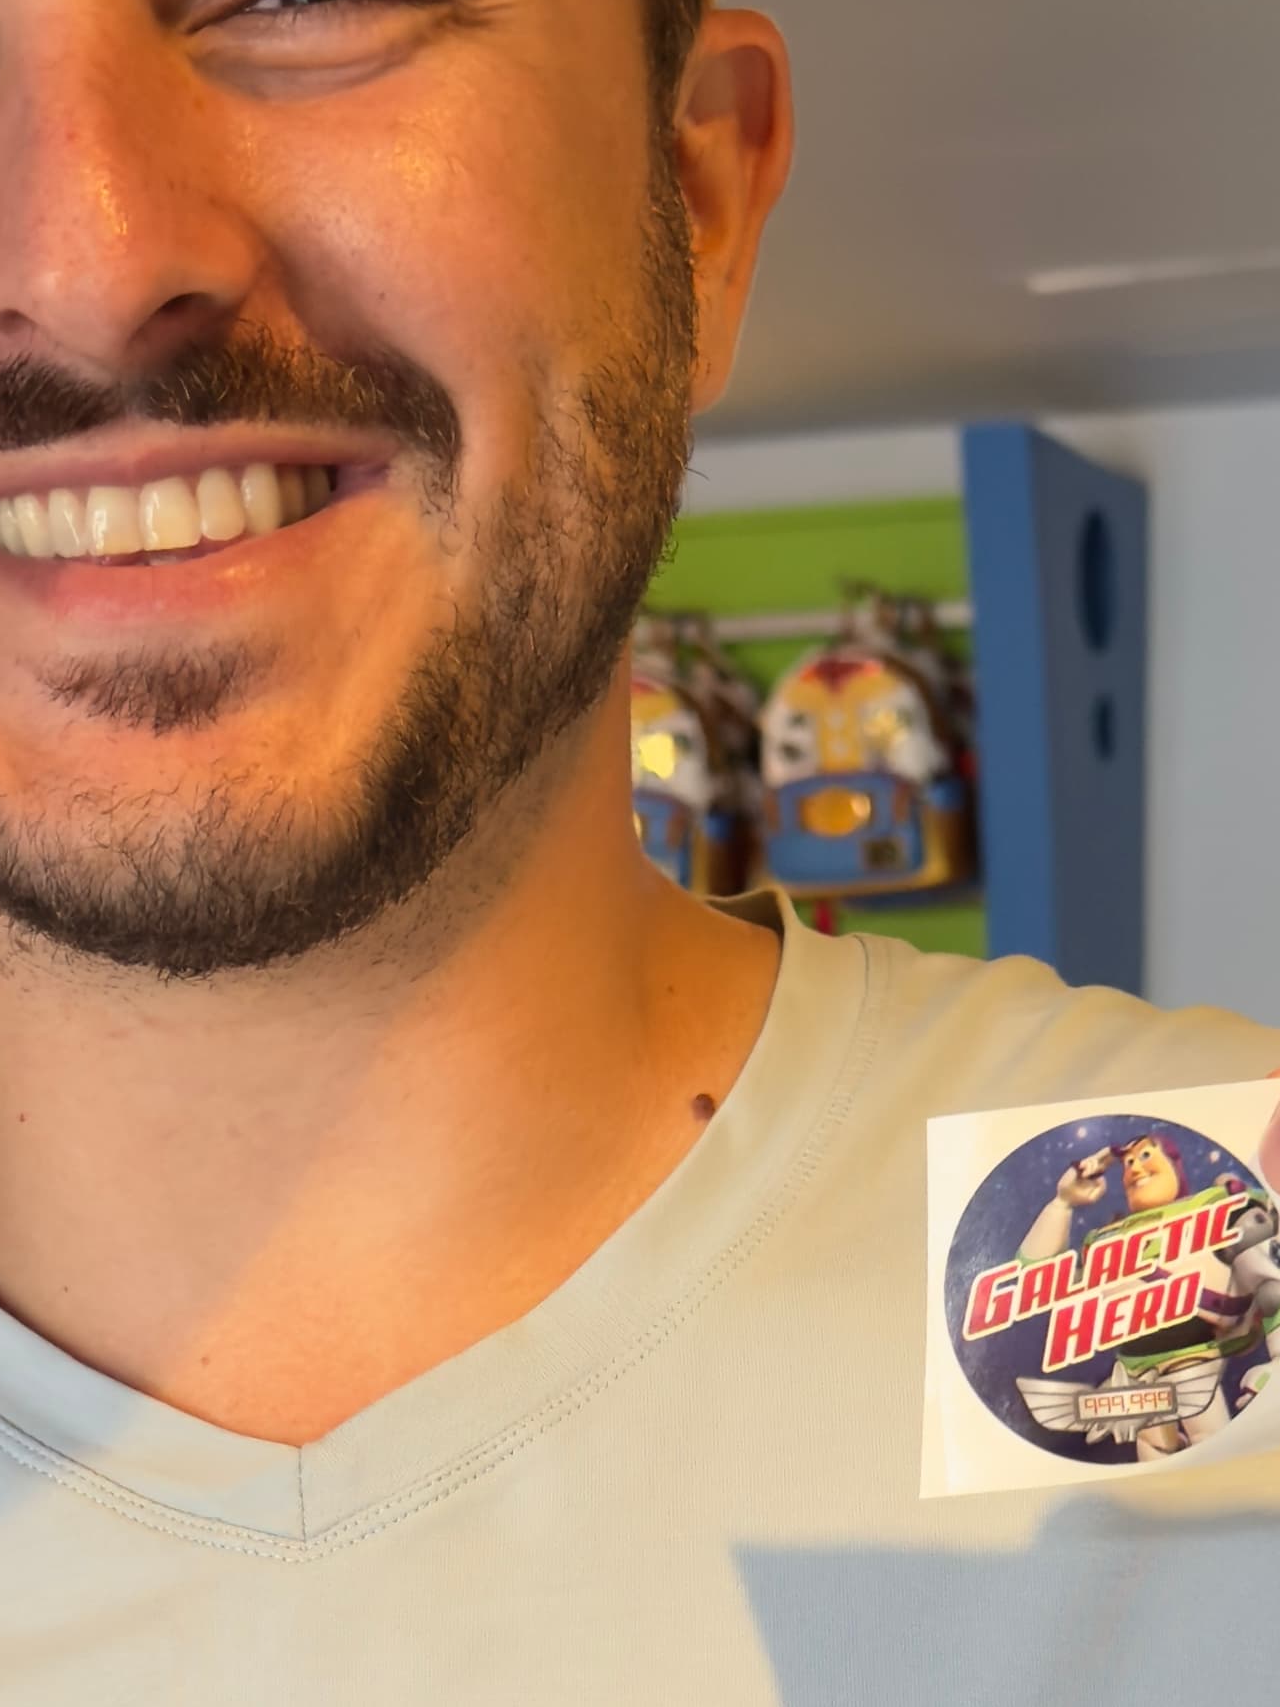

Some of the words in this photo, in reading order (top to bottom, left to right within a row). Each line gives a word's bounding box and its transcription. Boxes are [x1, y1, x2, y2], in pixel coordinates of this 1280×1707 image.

[965, 1196, 1246, 1338] GALACTIC
[1044, 1271, 1202, 1370] HERO
[1084, 1390, 1172, 1415] 999,999
